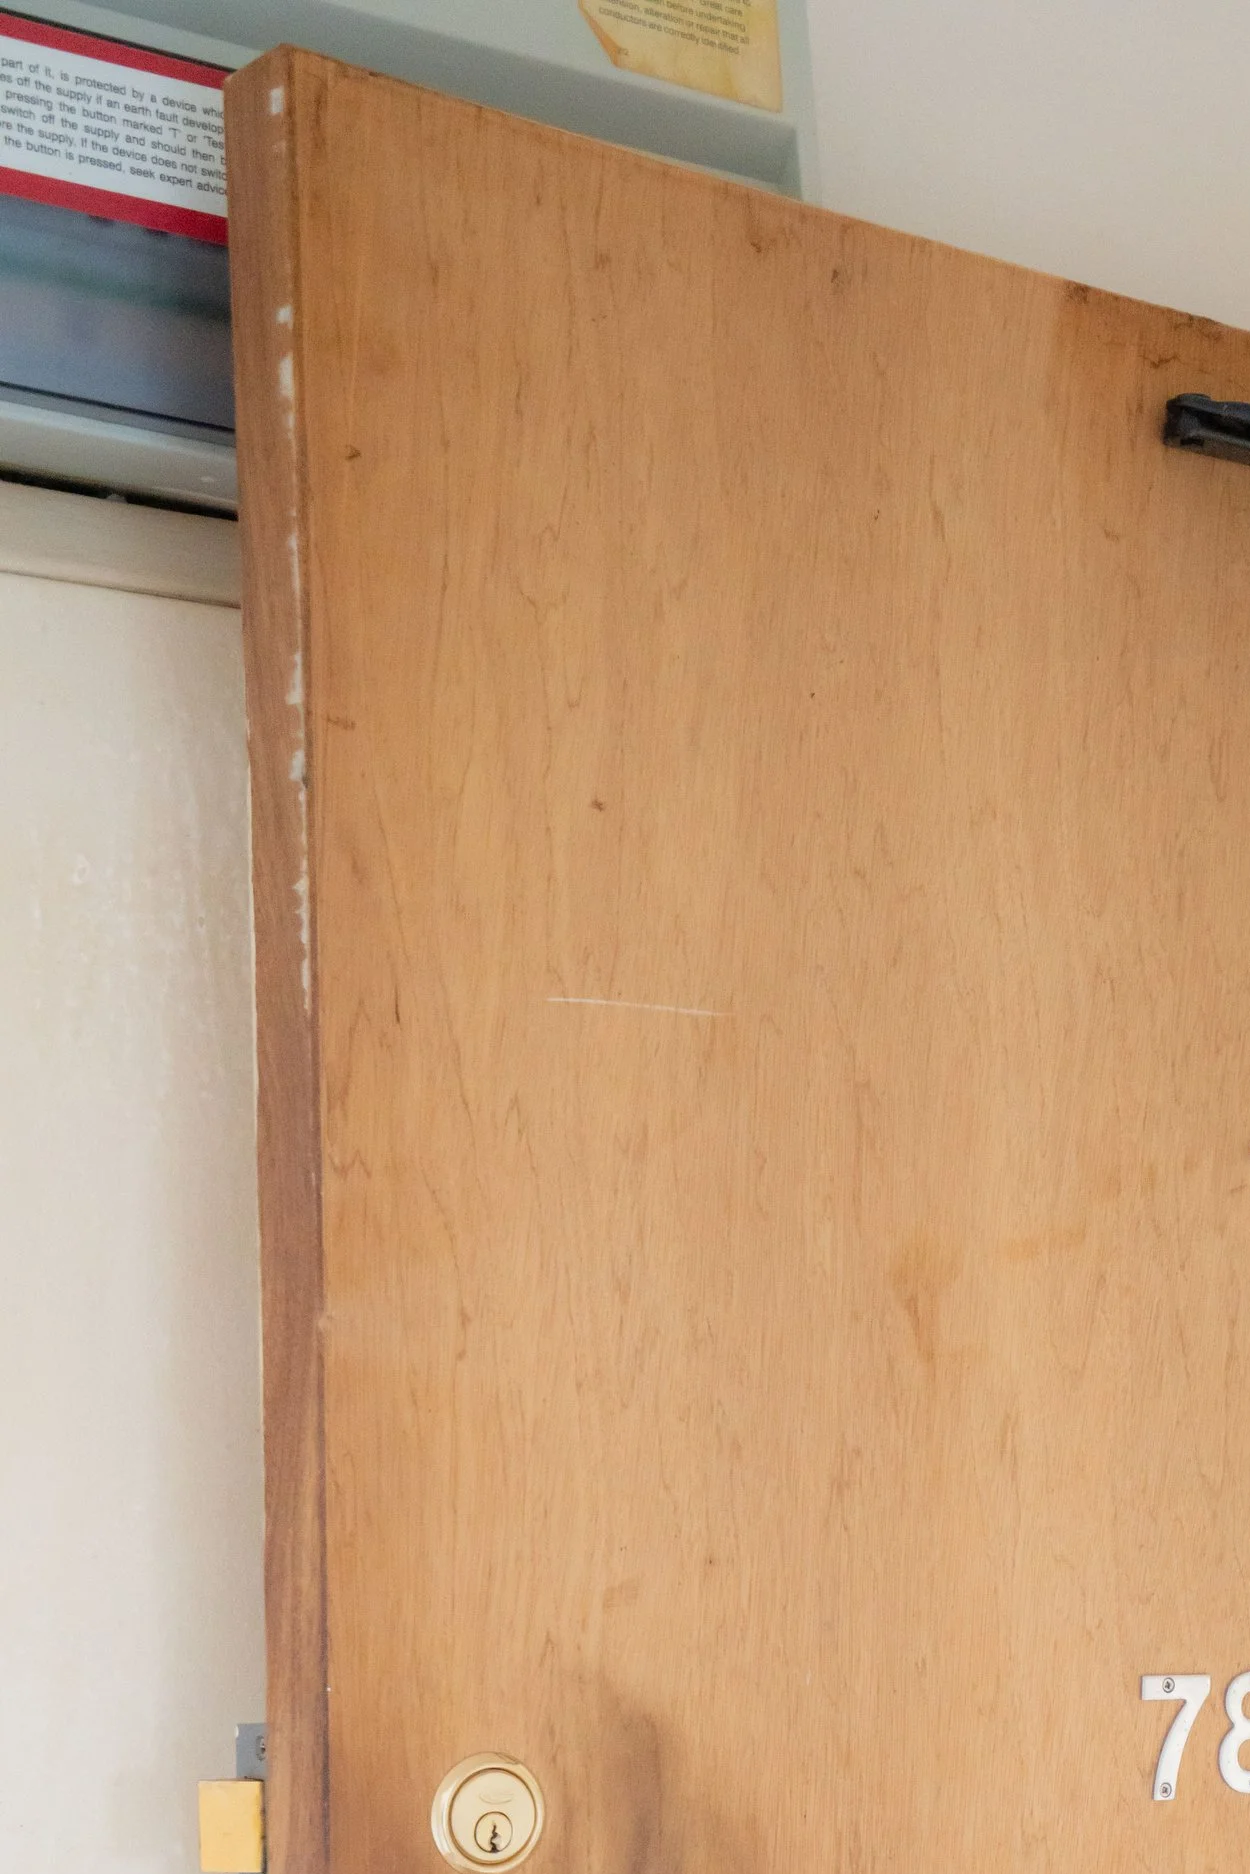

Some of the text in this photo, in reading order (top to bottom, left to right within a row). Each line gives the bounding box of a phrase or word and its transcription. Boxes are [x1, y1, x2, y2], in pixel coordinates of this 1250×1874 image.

[1, 58, 23, 70] part
[29, 64, 39, 73] of
[60, 70, 70, 81] is
[75, 76, 126, 95] protected
[132, 88, 144, 101] by
[150, 94, 157, 102] a
[162, 97, 196, 112] device
[17, 77, 30, 86] off
[35, 80, 52, 93] the
[56, 87, 92, 104] supply
[97, 94, 102, 104] if
[107, 100, 120, 109] an
[124, 103, 151, 117] earth
[156, 109, 178, 123] fault
[1, 105, 36, 120] switch
[42, 114, 55, 124] off
[61, 118, 78, 130] the
[84, 125, 120, 142] supply
[125, 134, 146, 146] and
[151, 140, 186, 156] should
[192, 149, 215, 162] then
[6, 90, 53, 111] pressing
[59, 102, 76, 114] the
[82, 107, 116, 124] button
[123, 119, 162, 135] marked
[187, 134, 197, 143] or
[5, 136, 21, 148] the
[26, 141, 61, 157] button
[66, 149, 74, 160] is
[130, 166, 156, 179] seek
[160, 173, 193, 188] expert
[17, 123, 34, 136] the
[38, 129, 76, 147] supply.
[81, 138, 87, 148] If
[91, 140, 108, 153] the
[112, 147, 147, 161] device
[151, 155, 177, 169] does
[181, 163, 197, 174] not
